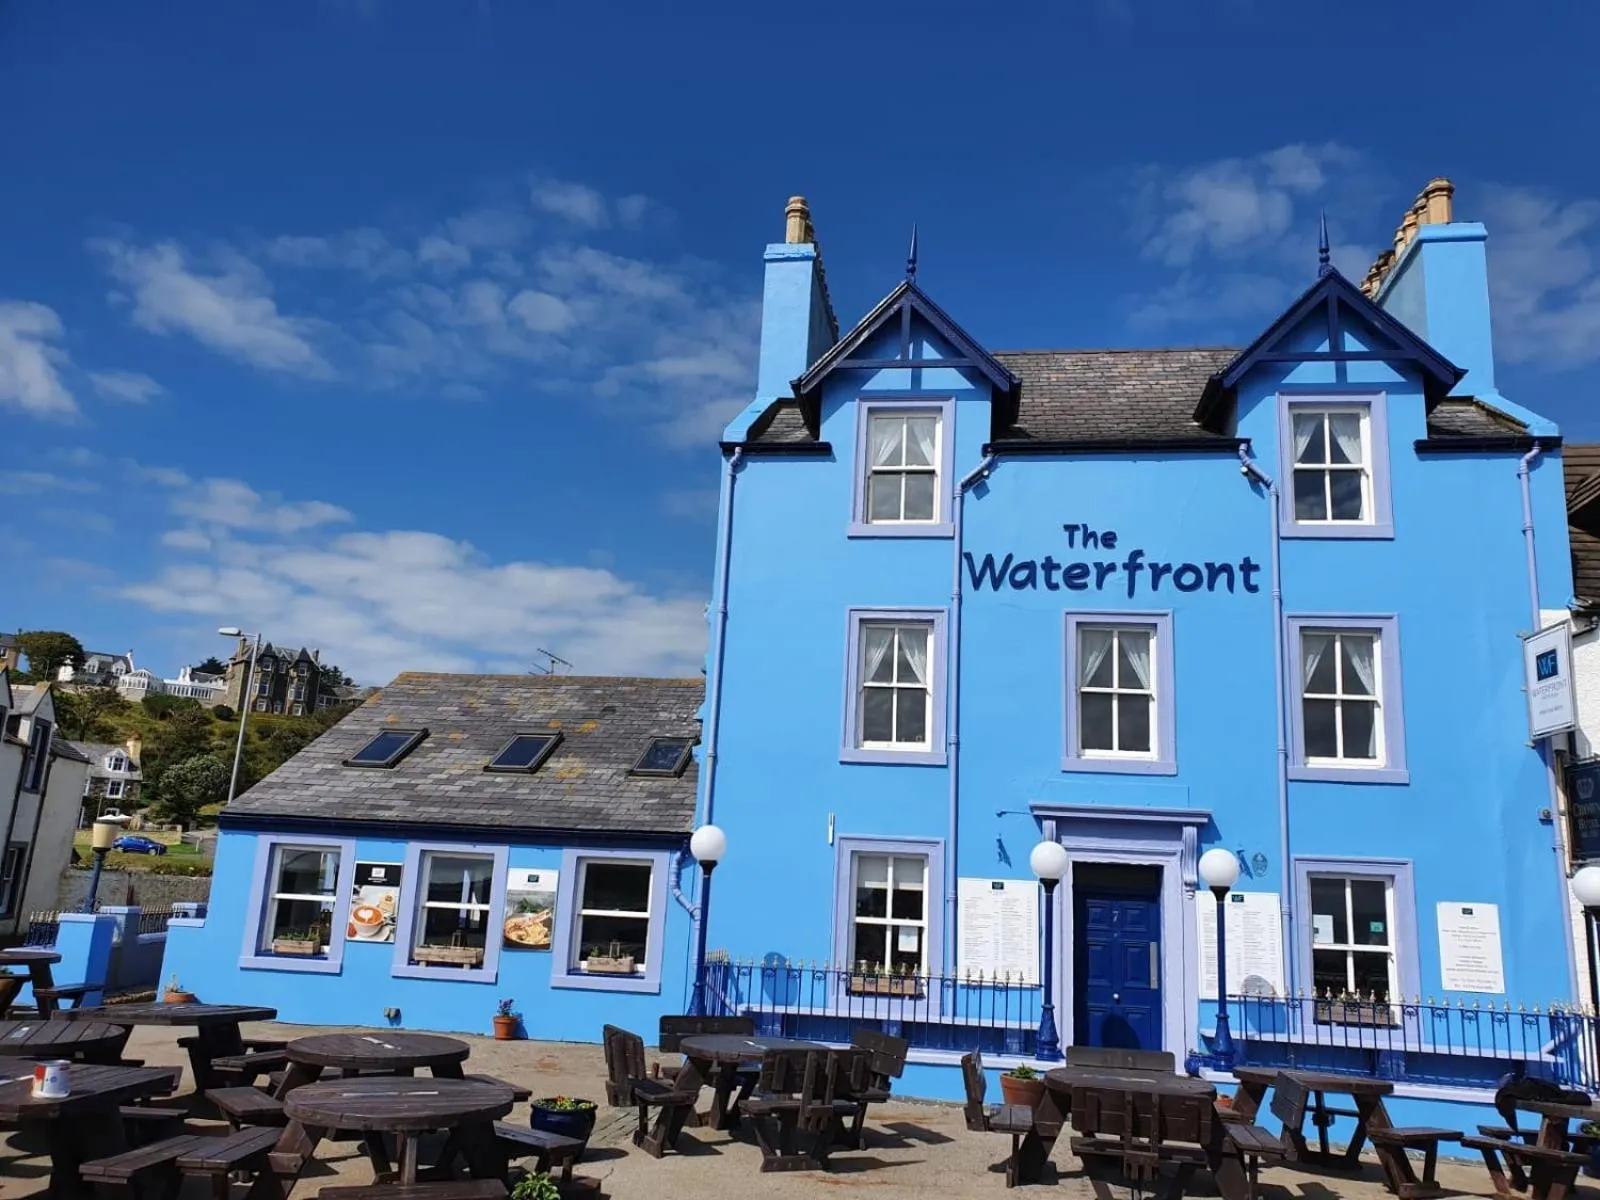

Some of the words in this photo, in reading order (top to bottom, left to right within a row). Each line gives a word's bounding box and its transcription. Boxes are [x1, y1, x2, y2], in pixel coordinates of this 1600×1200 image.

[1063, 523, 1117, 549] The
[962, 550, 1261, 598] Waterfront
[1537, 653, 1558, 677] WF
[1112, 910, 1119, 923] 7
